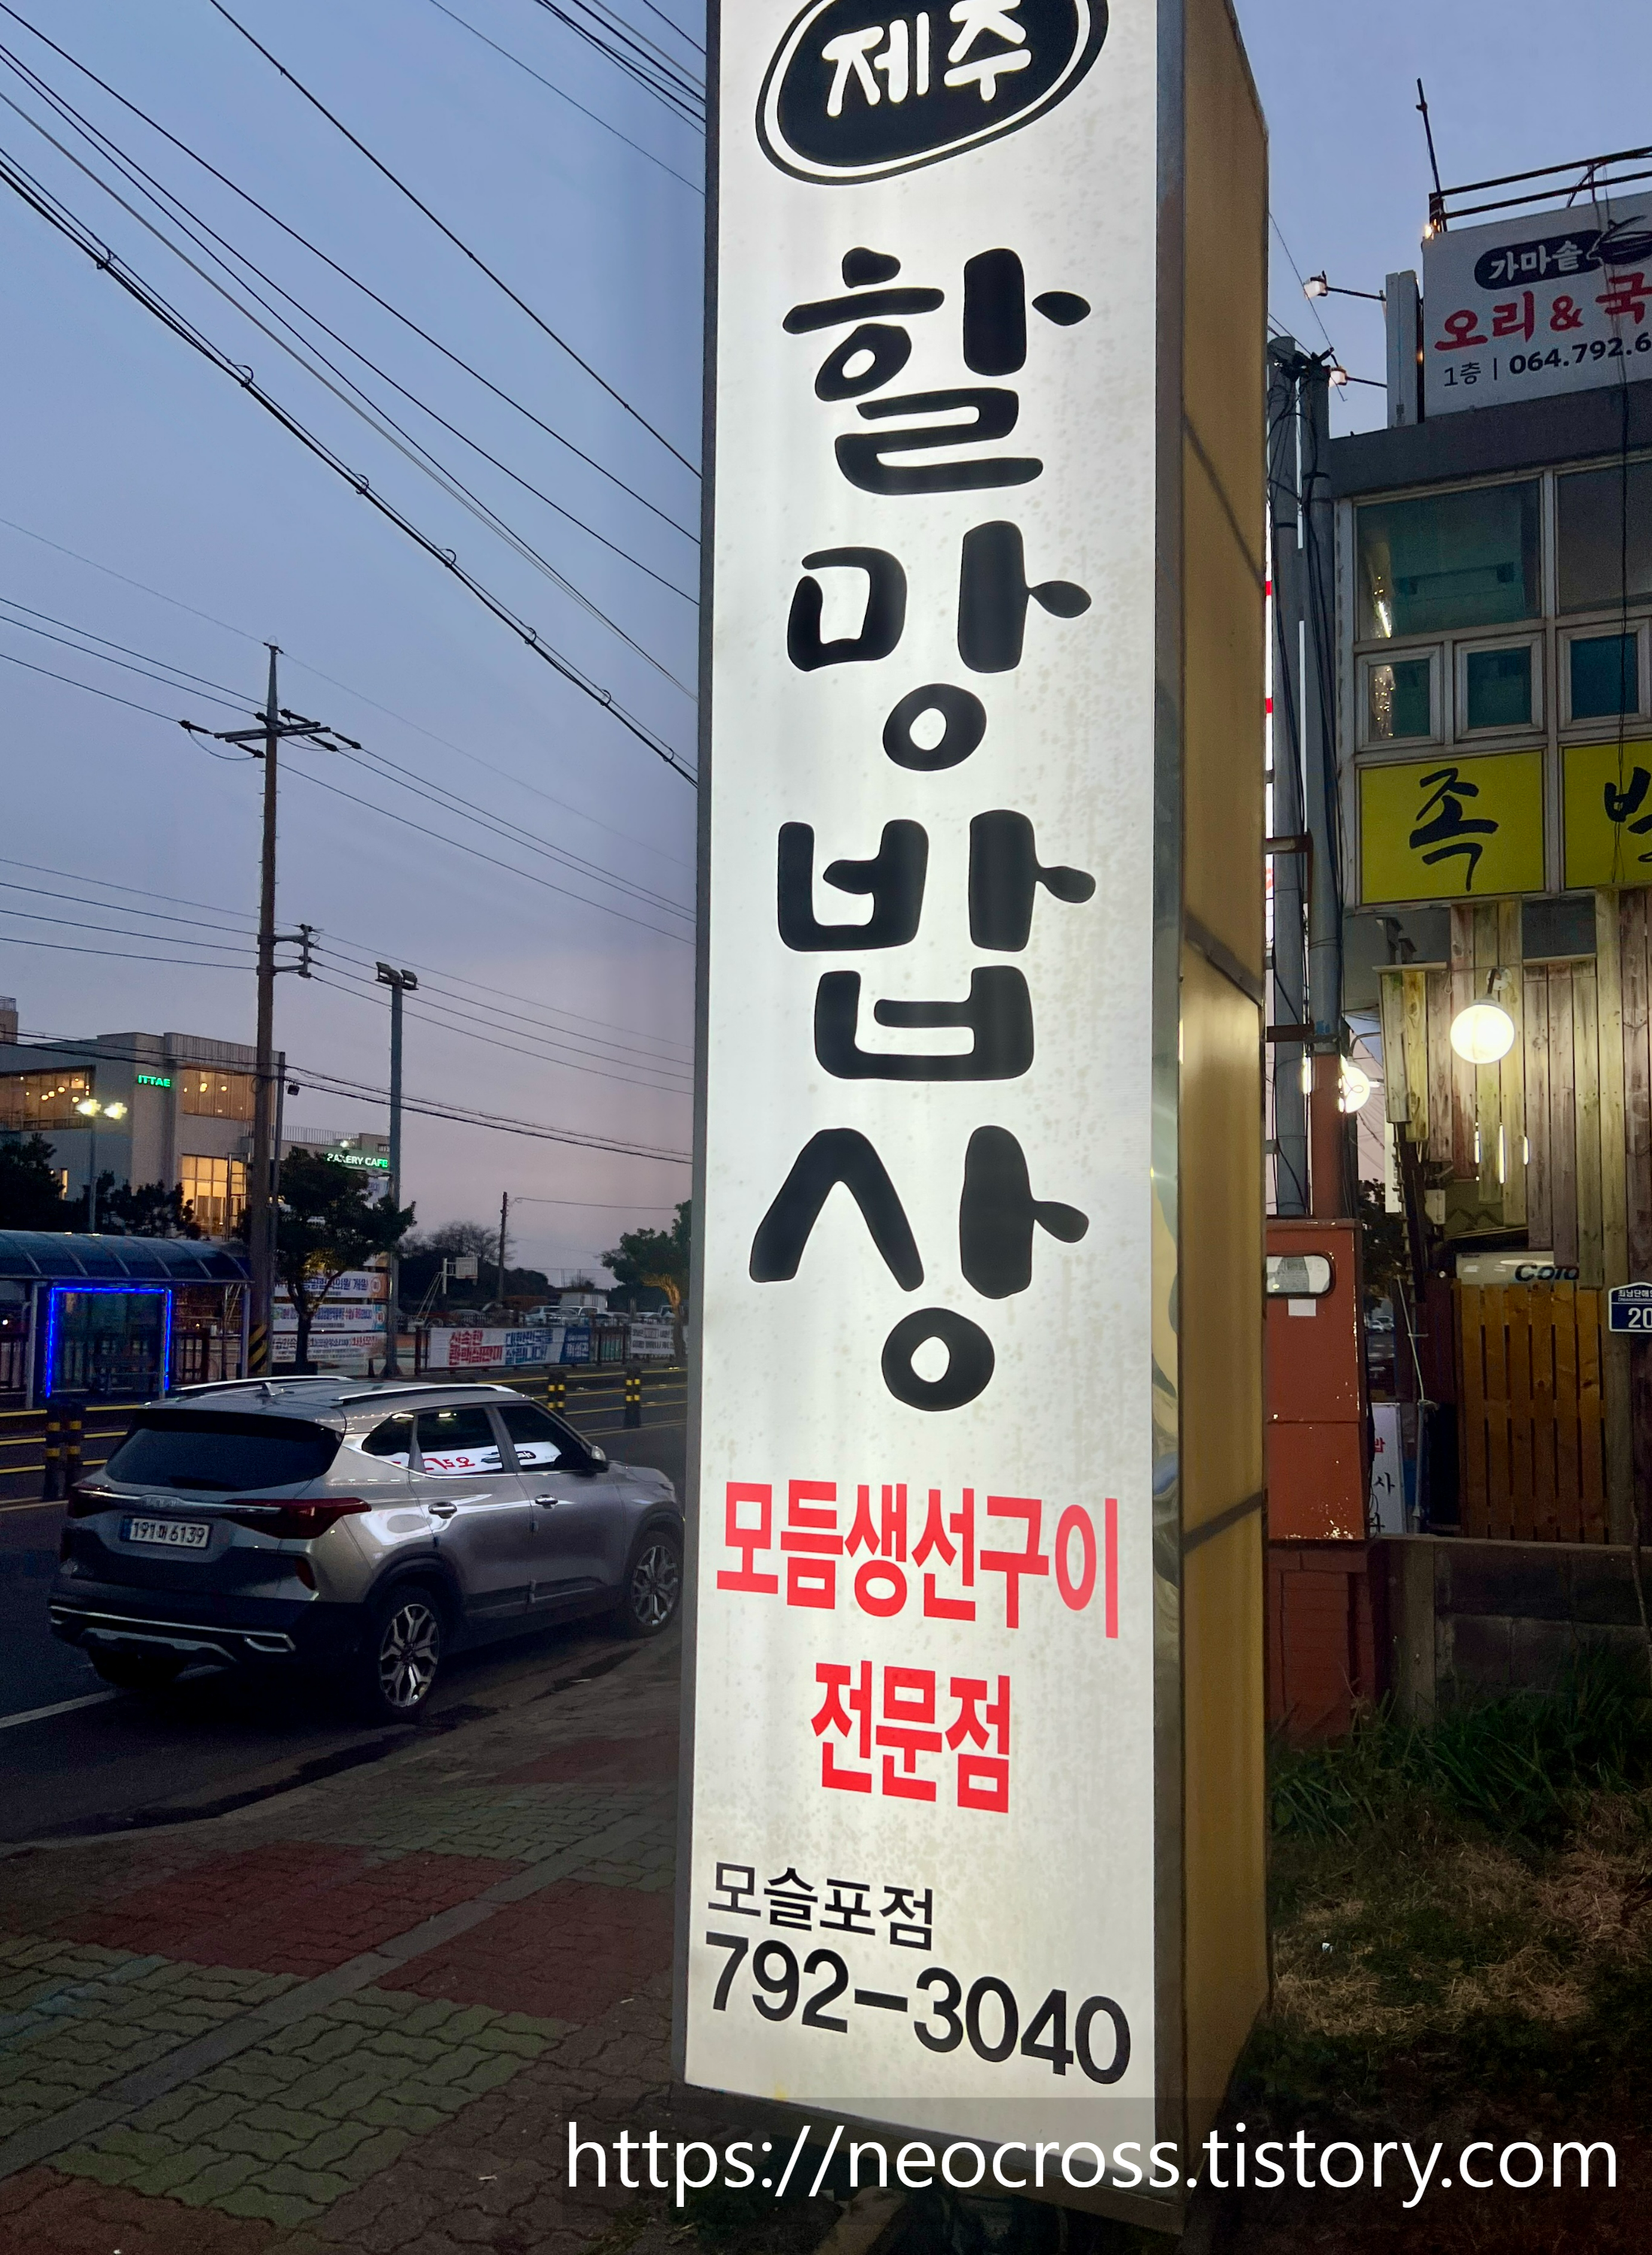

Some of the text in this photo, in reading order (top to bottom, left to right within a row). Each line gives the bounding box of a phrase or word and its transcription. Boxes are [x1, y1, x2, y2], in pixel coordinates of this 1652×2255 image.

[821, 0, 1032, 117] 제주
[1488, 241, 1584, 281] 가마솥
[1444, 362, 1481, 387] 1층
[749, 247, 1096, 1412] 할망밥상
[138, 1074, 171, 1088] ITTAE
[365, 1157, 389, 1168] CAFE
[716, 1479, 1119, 1639] 모듬생선구이
[811, 1660, 1010, 1814] 전문점
[707, 1862, 933, 1951] 모슬포점
[705, 1931, 1131, 2084] 792-3040
